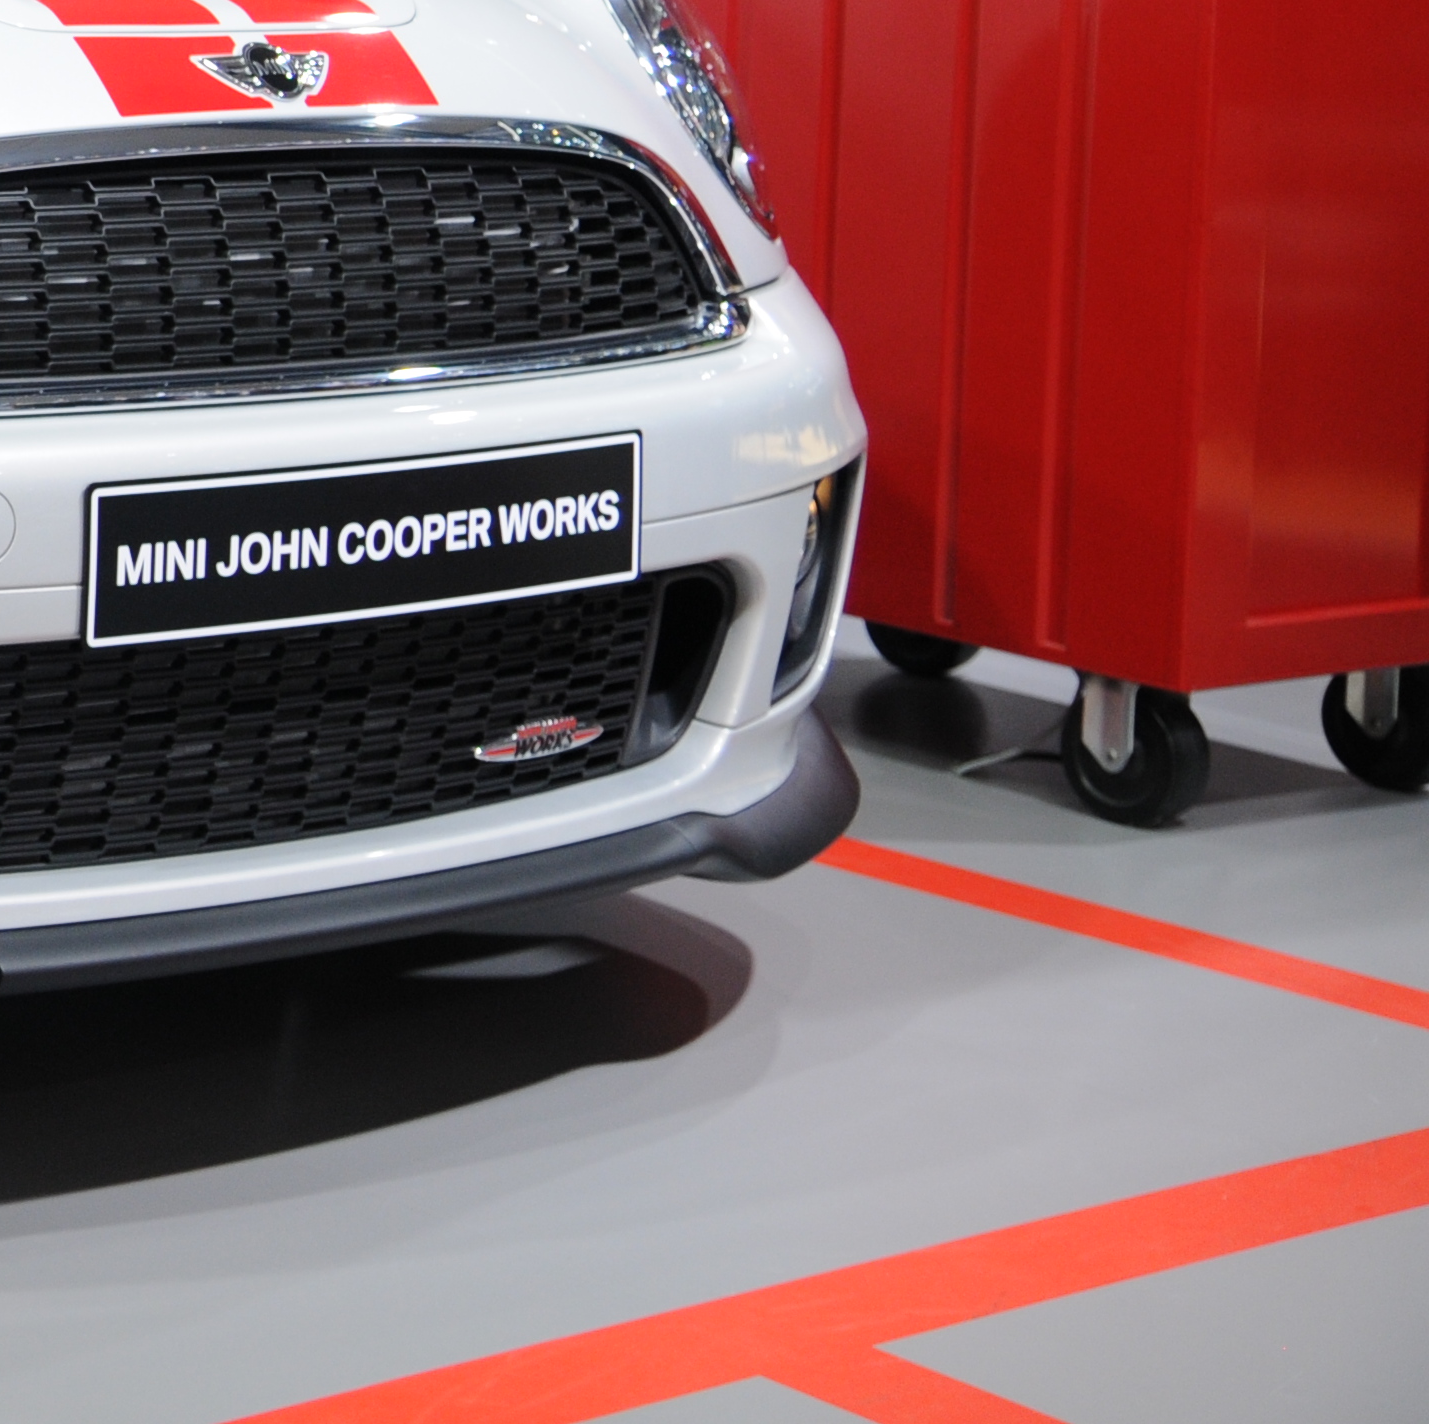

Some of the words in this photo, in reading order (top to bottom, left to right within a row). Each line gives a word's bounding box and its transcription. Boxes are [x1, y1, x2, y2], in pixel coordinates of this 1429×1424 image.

[116, 538, 207, 587] MINI
[215, 526, 329, 578] JOHN
[337, 507, 492, 565] COOPER
[498, 489, 620, 545] WORKS
